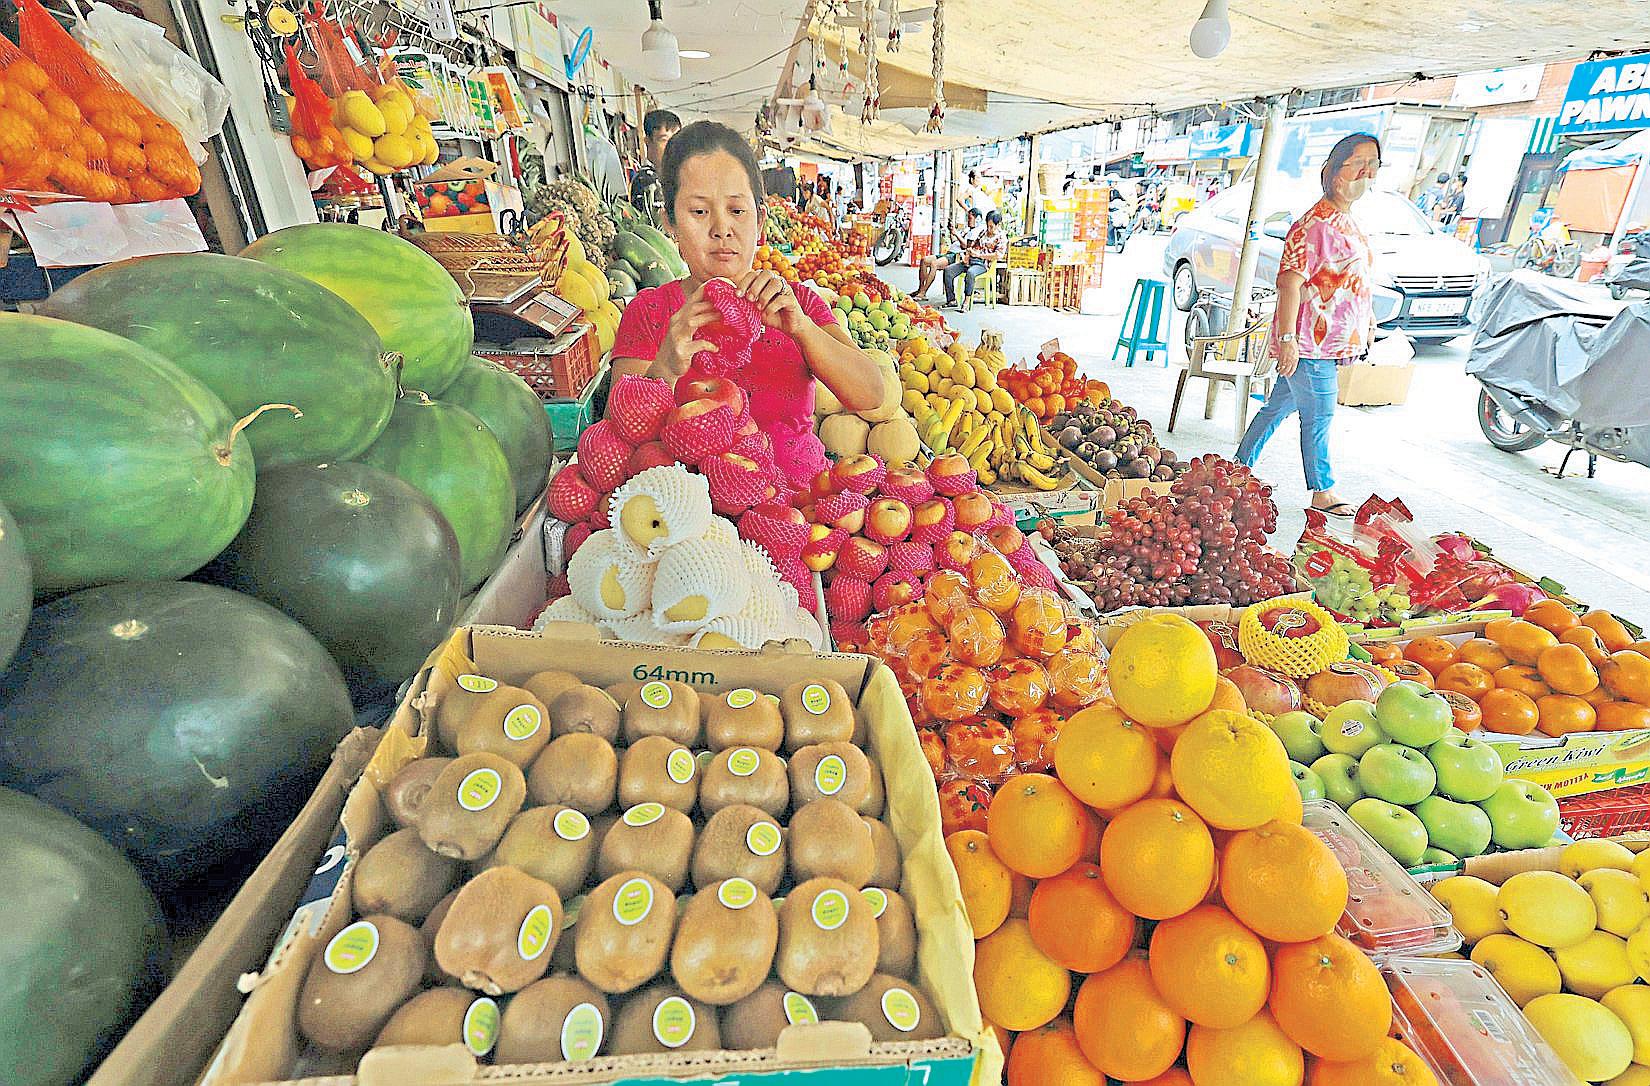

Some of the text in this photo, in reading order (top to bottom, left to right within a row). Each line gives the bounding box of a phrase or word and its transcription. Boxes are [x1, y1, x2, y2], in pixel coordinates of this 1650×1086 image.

[1504, 744, 1606, 773] Green Kiwi
[1554, 772, 1589, 791] YELLOW
